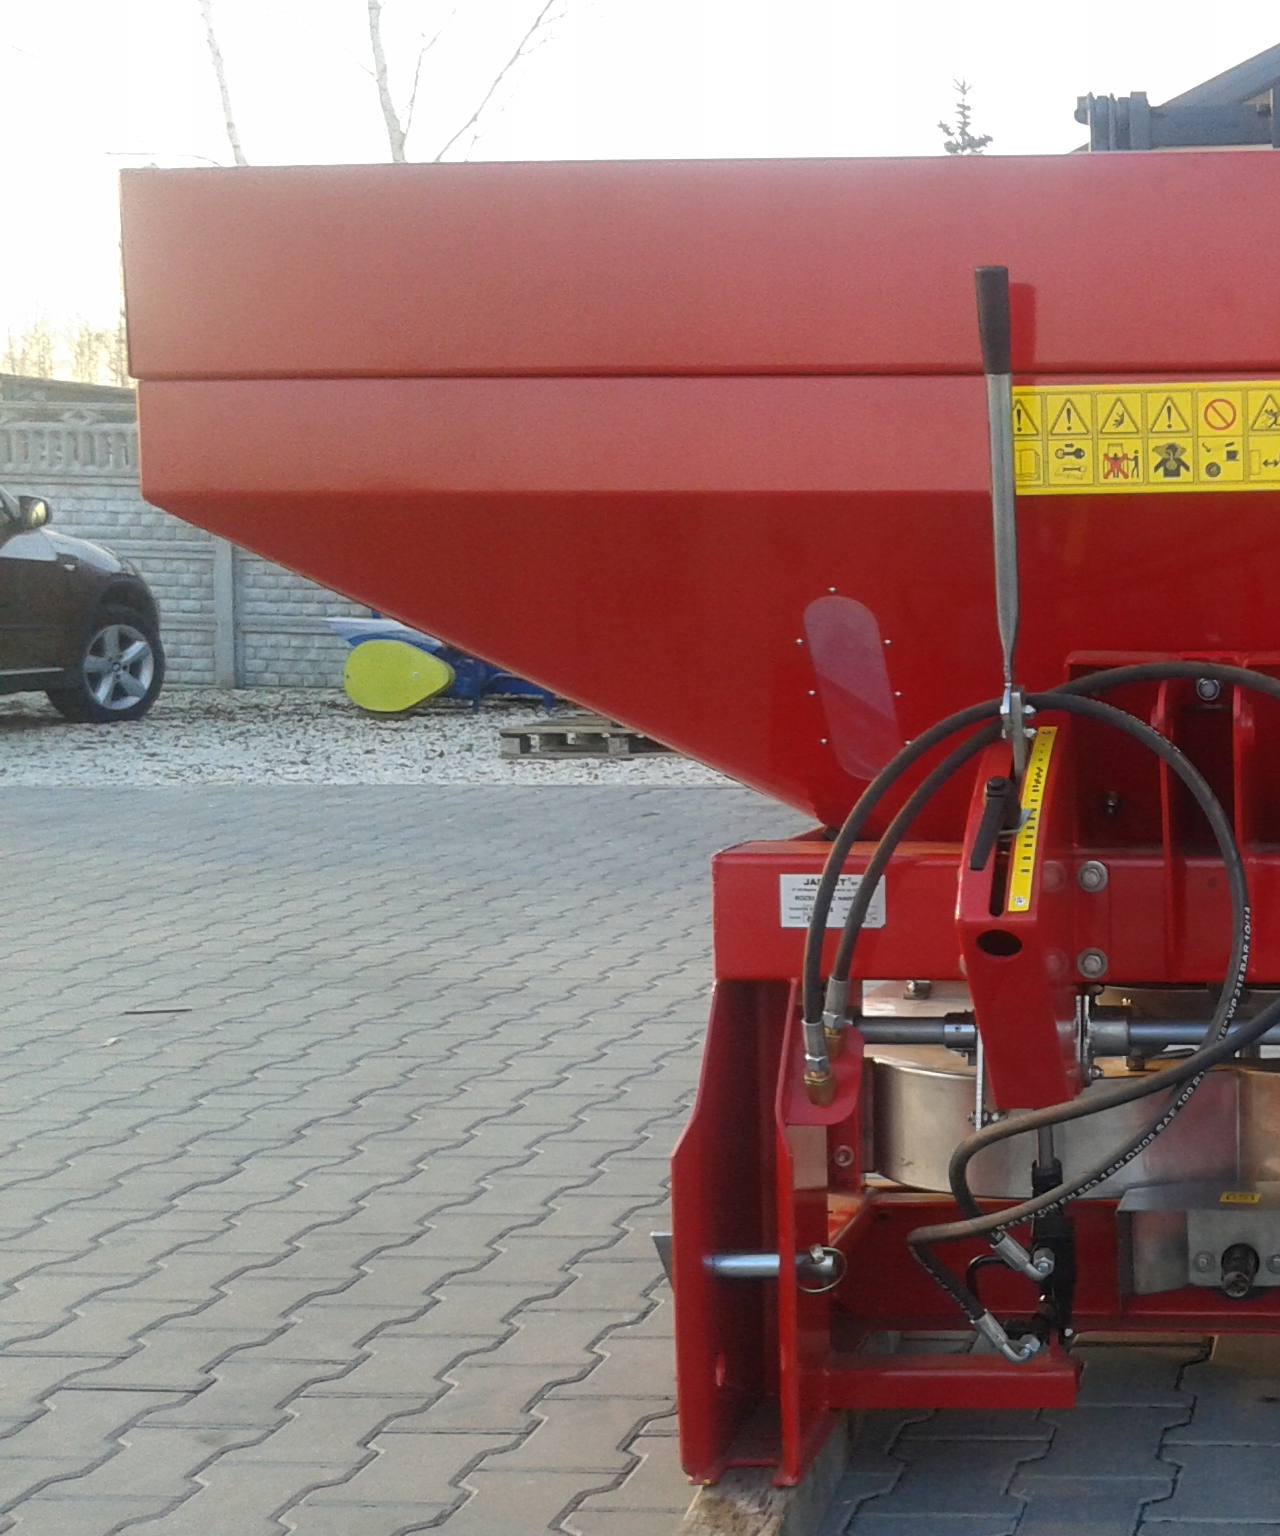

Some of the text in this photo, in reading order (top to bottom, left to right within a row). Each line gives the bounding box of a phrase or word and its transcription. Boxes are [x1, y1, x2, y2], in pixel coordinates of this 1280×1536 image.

[1177, 1086, 1194, 1106] 100
[1226, 997, 1237, 1018] WP
[1239, 944, 1250, 973] BAR
